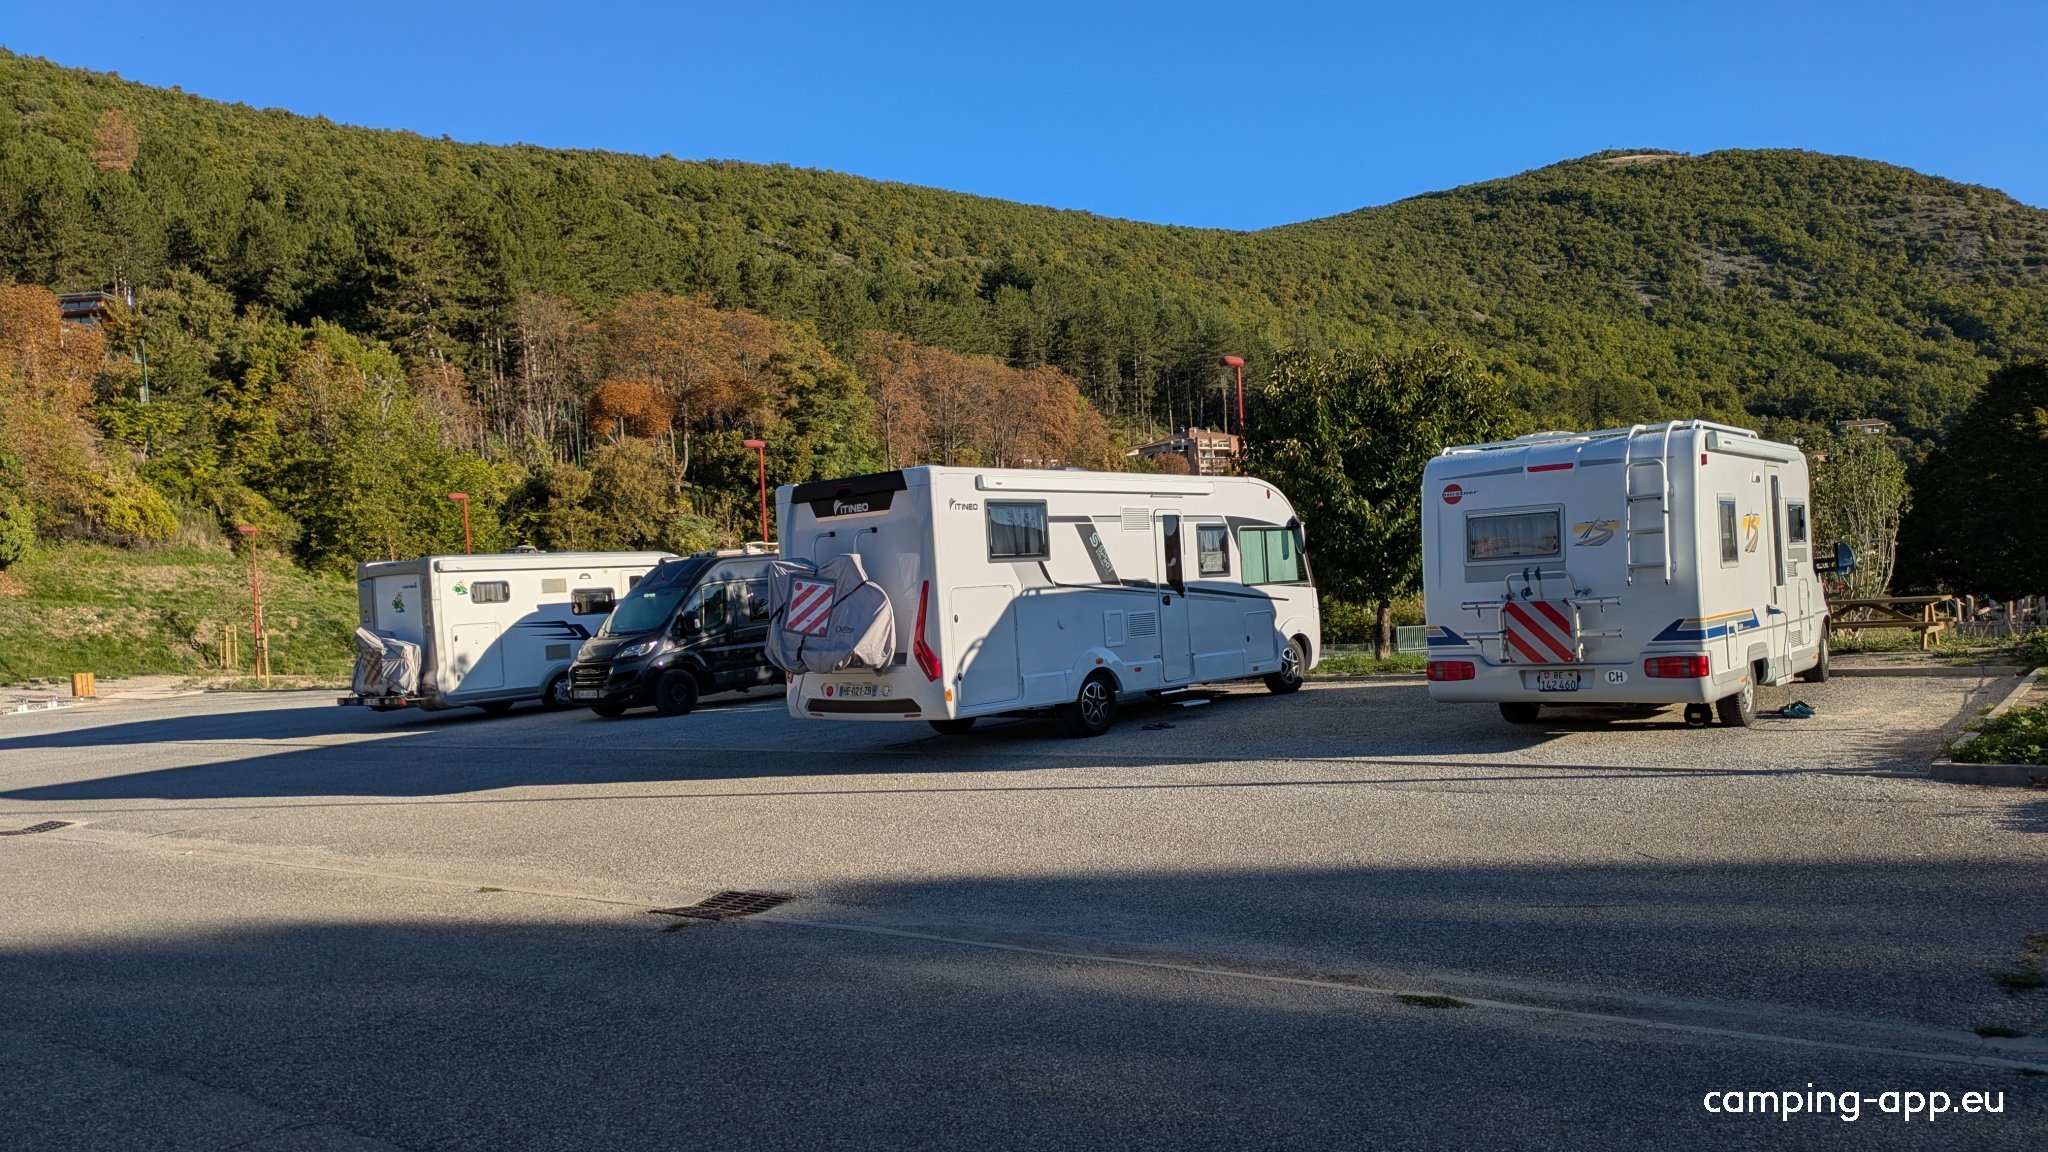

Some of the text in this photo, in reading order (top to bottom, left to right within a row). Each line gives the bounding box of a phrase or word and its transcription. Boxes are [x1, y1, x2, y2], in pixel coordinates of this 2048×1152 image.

[840, 502, 869, 515] ITINEO
[954, 503, 978, 511] ITINEO
[1553, 671, 1563, 679] BE
[1608, 671, 1624, 683] CH
